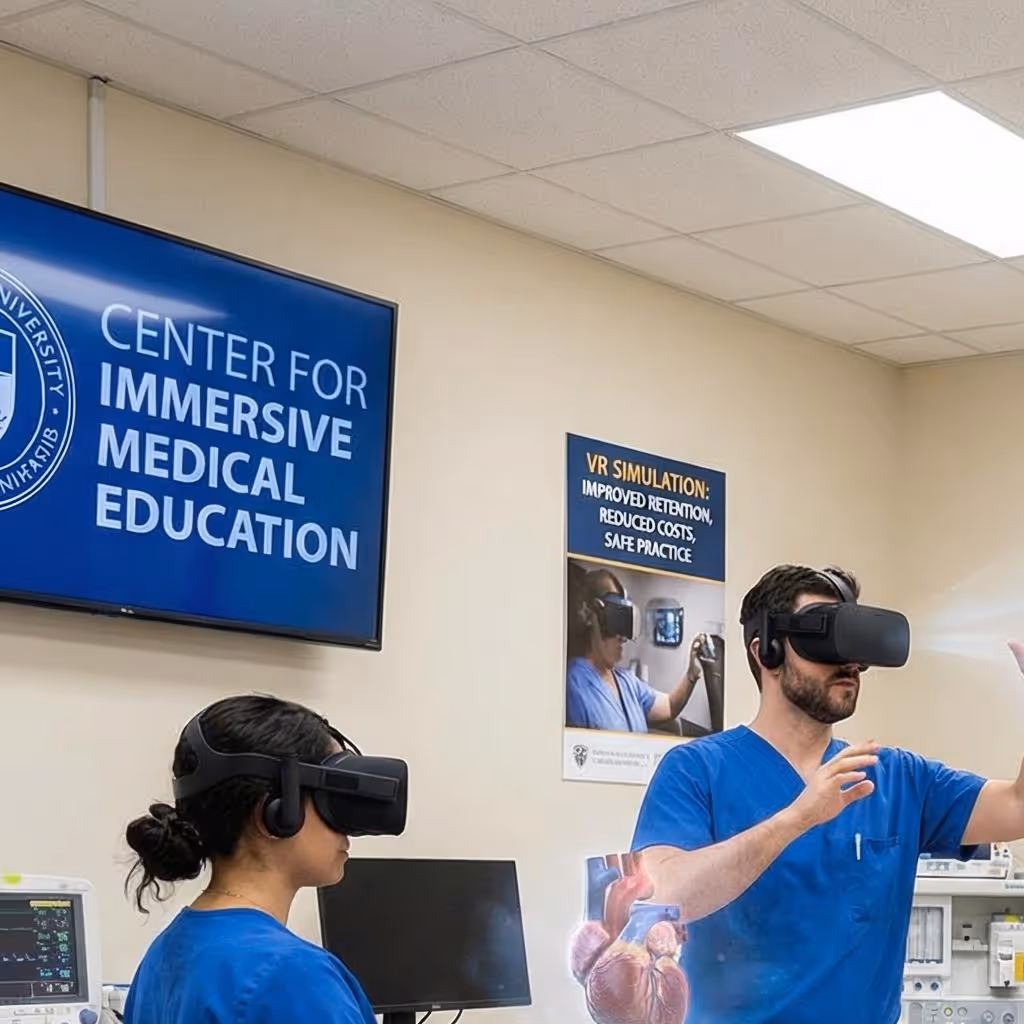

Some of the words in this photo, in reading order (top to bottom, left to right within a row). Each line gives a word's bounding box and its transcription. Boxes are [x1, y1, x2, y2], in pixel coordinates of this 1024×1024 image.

[0, 284, 65, 397] NIVERSITY
[101, 303, 275, 387] CENTER
[289, 350, 368, 410] FOR
[100, 362, 353, 461] IMMERSIVE
[97, 423, 306, 505] MEDICAL
[582, 479, 646, 508] IMPROVED
[648, 494, 713, 526] RETENTION,
[586, 452, 608, 476] VR
[612, 459, 710, 500] SIMULATION:
[95, 483, 359, 571] EDUCATION
[599, 506, 656, 533] REDUCED
[657, 520, 696, 544] COSTS,
[604, 531, 635, 552] SAFE
[637, 538, 692, 563] PRACTICE
